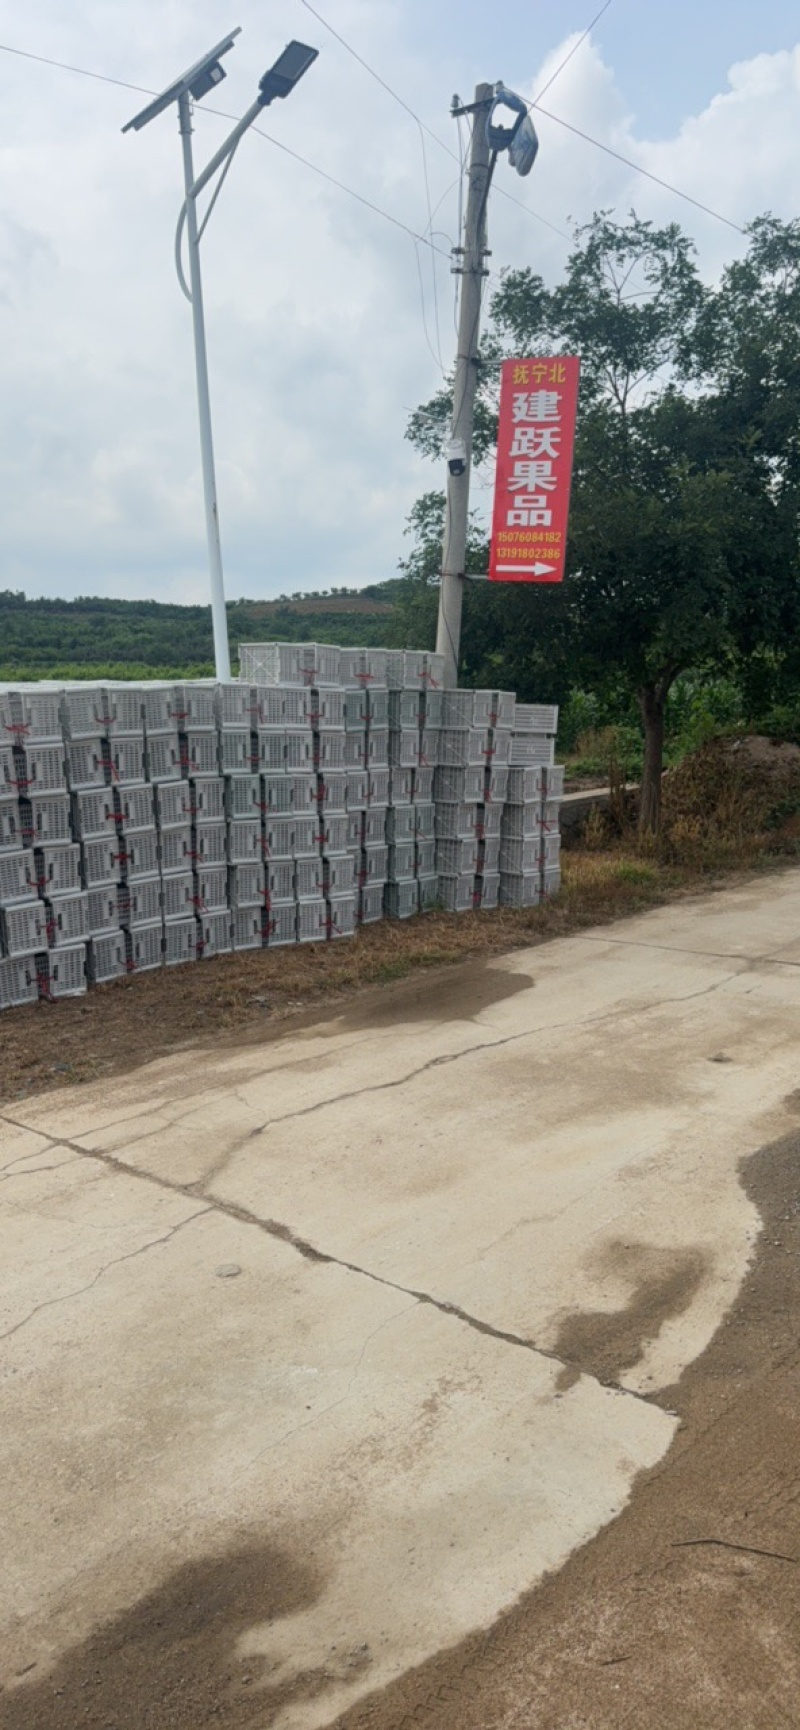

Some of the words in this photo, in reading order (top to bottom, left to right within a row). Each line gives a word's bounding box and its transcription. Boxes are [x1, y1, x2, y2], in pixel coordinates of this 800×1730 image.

[513, 363, 566, 385] 抚宁北
[506, 389, 563, 527] 建跃果品
[497, 532, 562, 543] 15076084182
[496, 547, 561, 559] 13191802386
